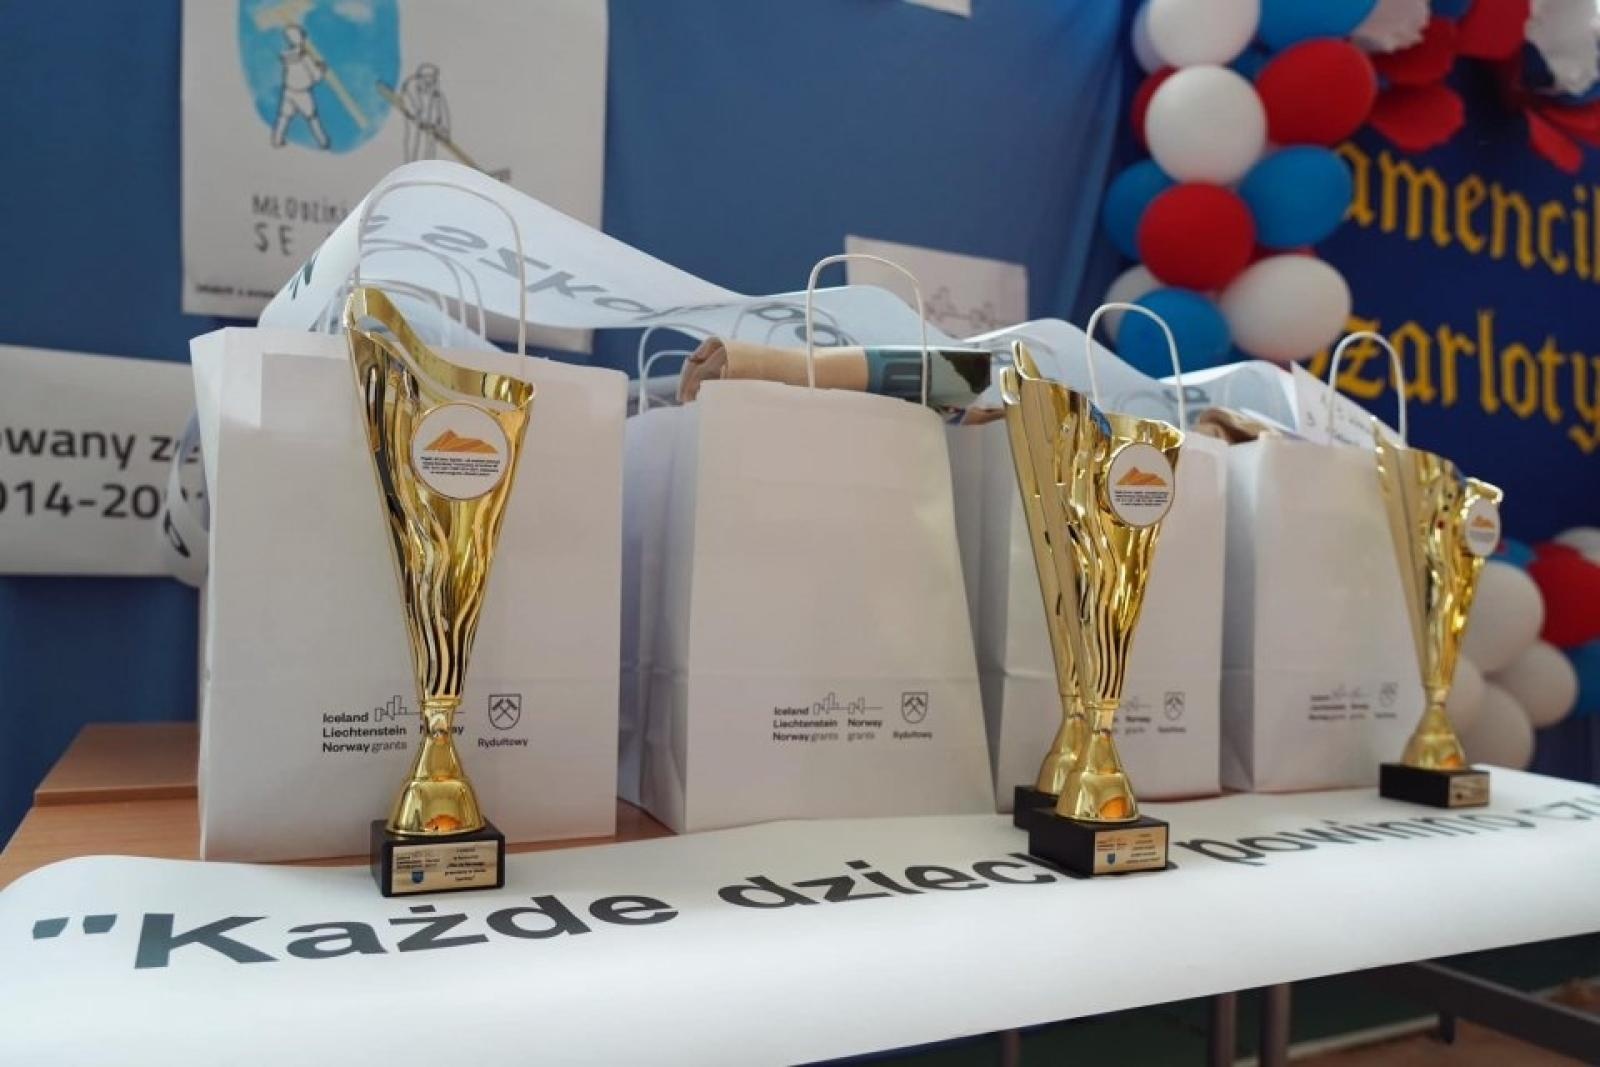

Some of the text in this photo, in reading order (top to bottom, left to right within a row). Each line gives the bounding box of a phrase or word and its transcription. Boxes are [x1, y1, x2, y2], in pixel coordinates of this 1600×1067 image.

[0, 427, 137, 471] wany
[774, 706, 809, 715] Iceland
[322, 712, 369, 723] Iceland
[773, 718, 838, 728] Liechtenstein
[322, 725, 407, 738] Liechtenstein
[773, 731, 809, 741] Norway
[322, 742, 371, 753] Norway
